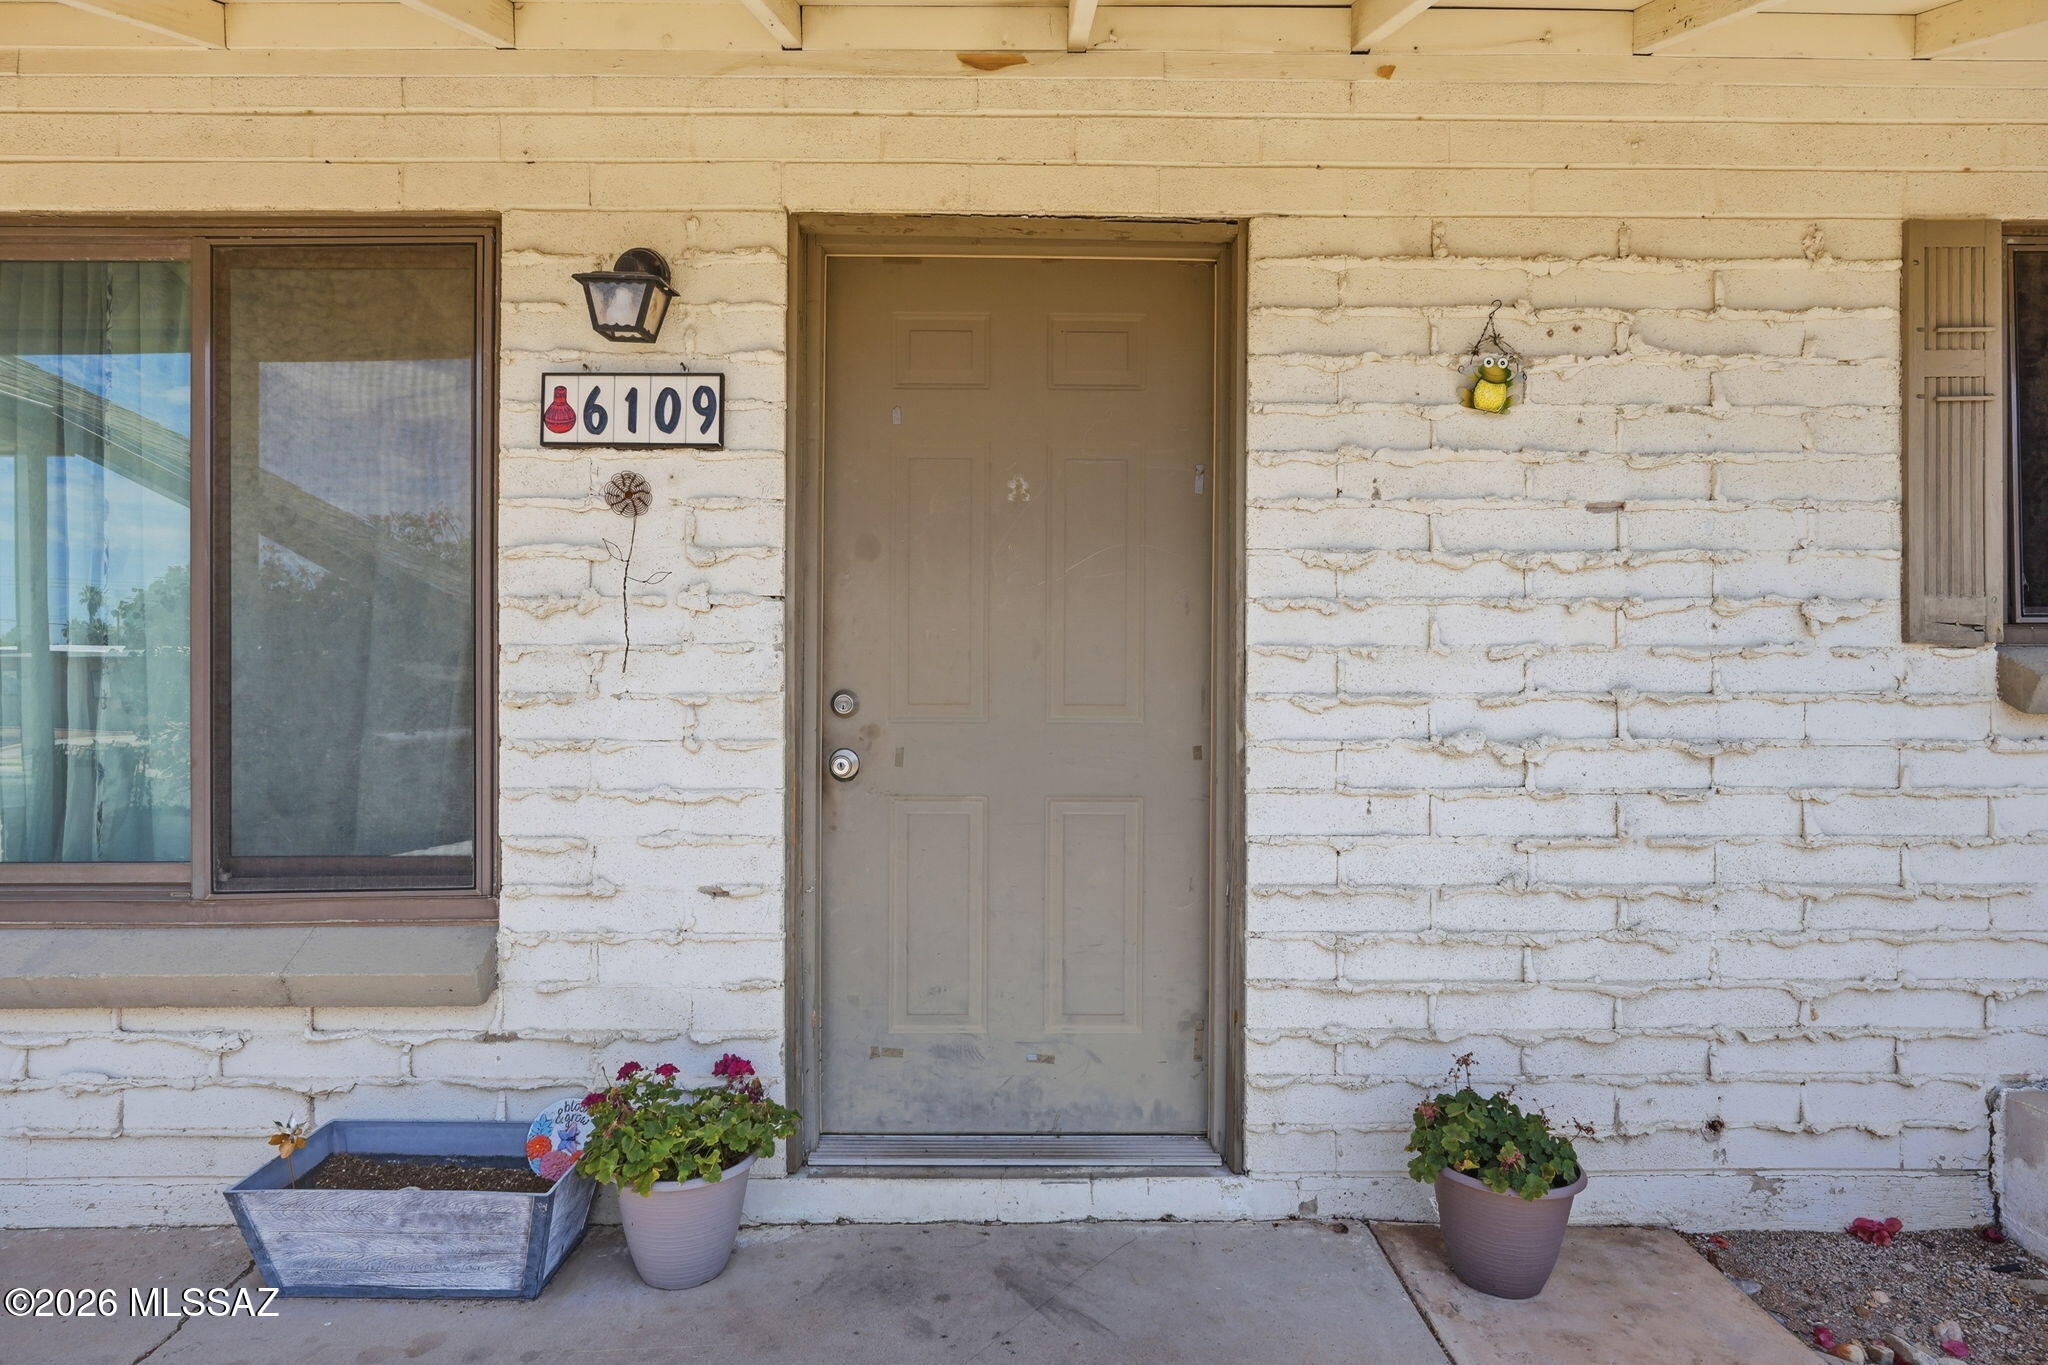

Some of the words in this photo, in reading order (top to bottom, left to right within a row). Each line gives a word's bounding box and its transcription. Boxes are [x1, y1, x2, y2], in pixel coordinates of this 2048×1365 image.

[583, 385, 717, 435] 6109
[564, 1100, 588, 1113] bloo
[564, 1112, 590, 1129] grow
